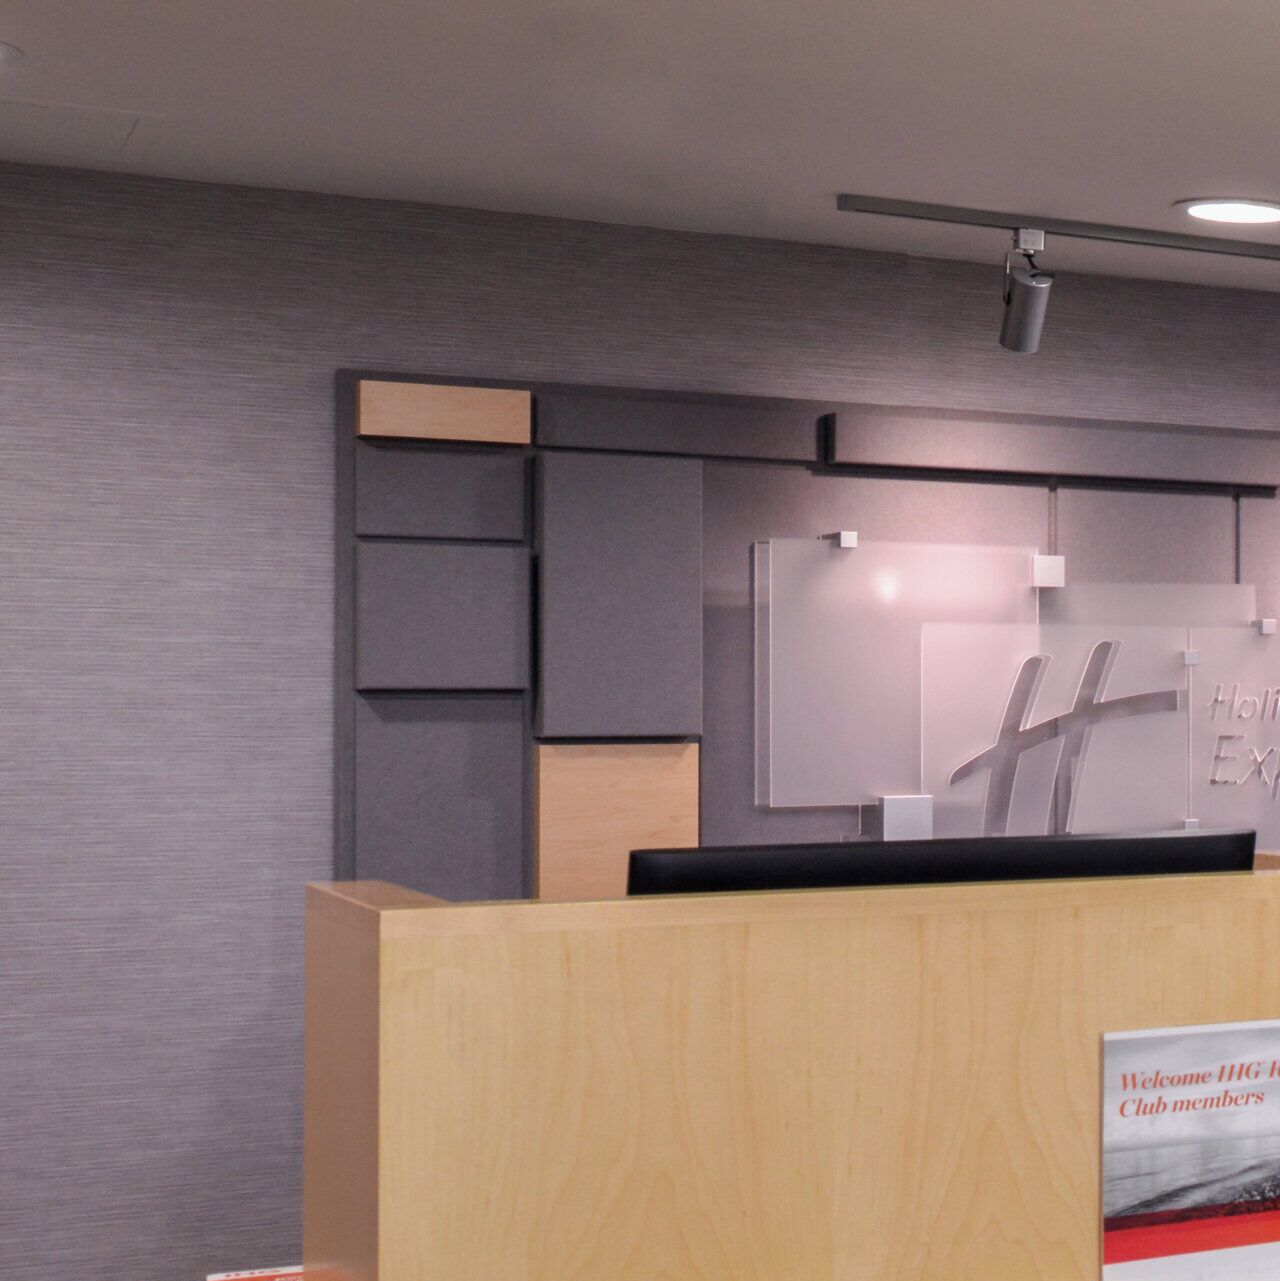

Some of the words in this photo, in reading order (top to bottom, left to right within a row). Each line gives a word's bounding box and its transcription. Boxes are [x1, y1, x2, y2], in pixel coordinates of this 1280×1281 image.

[1120, 1070, 1213, 1092] Welcome
[1217, 1061, 1262, 1084] IHG
[1119, 1096, 1168, 1119] Club
[1172, 1089, 1265, 1114] members
